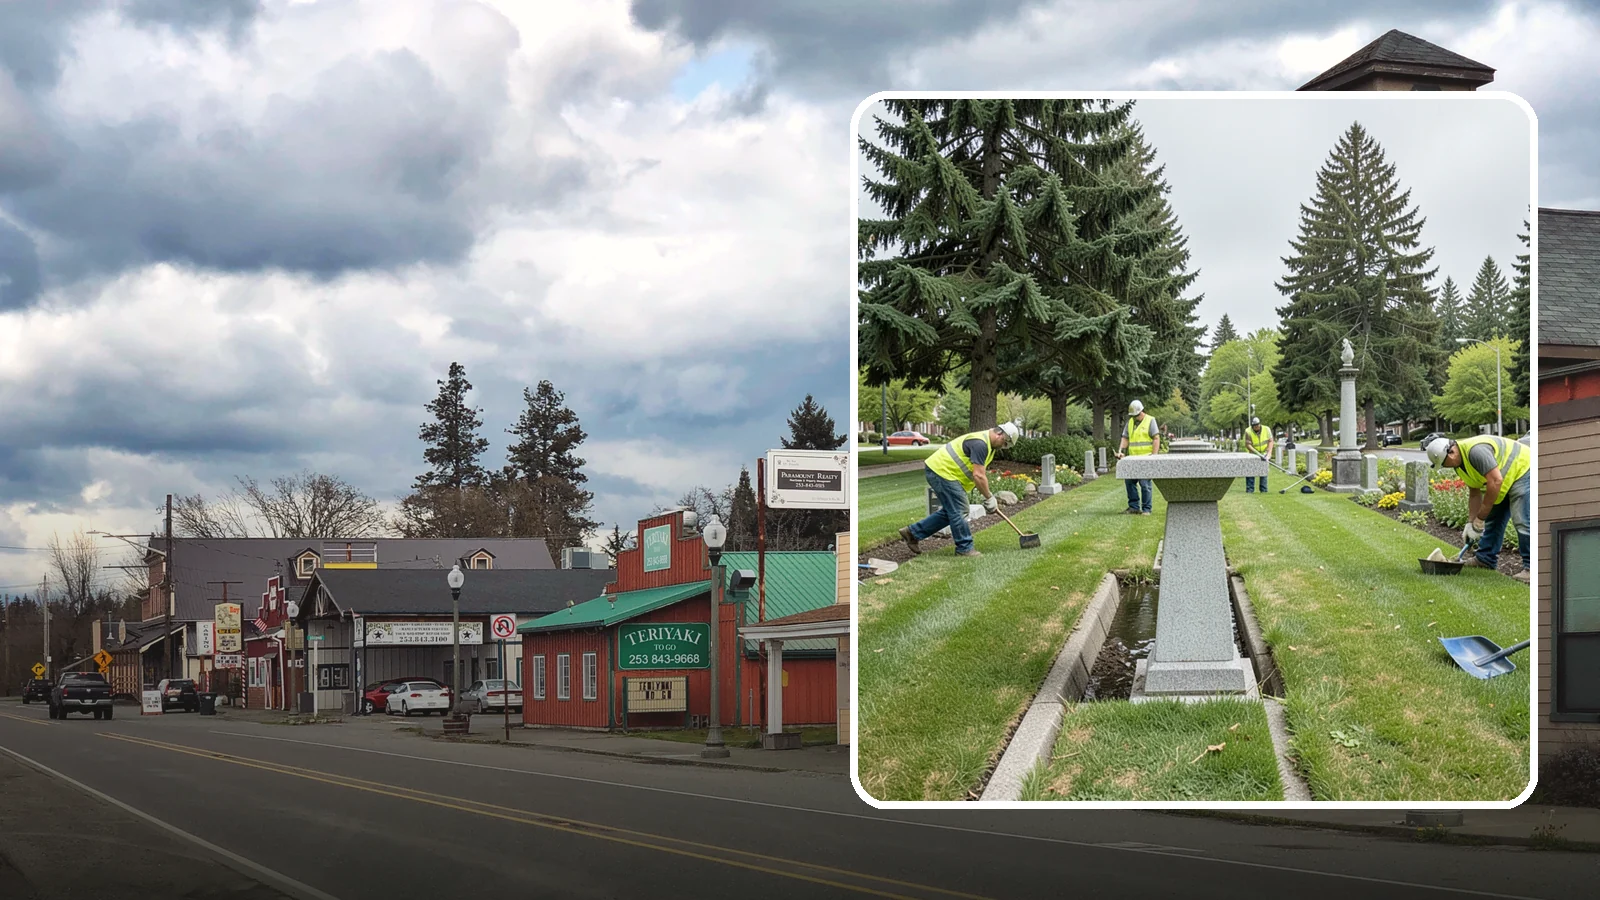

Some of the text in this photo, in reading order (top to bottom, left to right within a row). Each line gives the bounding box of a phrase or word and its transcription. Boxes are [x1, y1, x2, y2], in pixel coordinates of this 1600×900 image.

[625, 628, 702, 646] TERIYAKI
[629, 654, 700, 664] 253 843-9668
[639, 681, 672, 690] TERIYAKI
